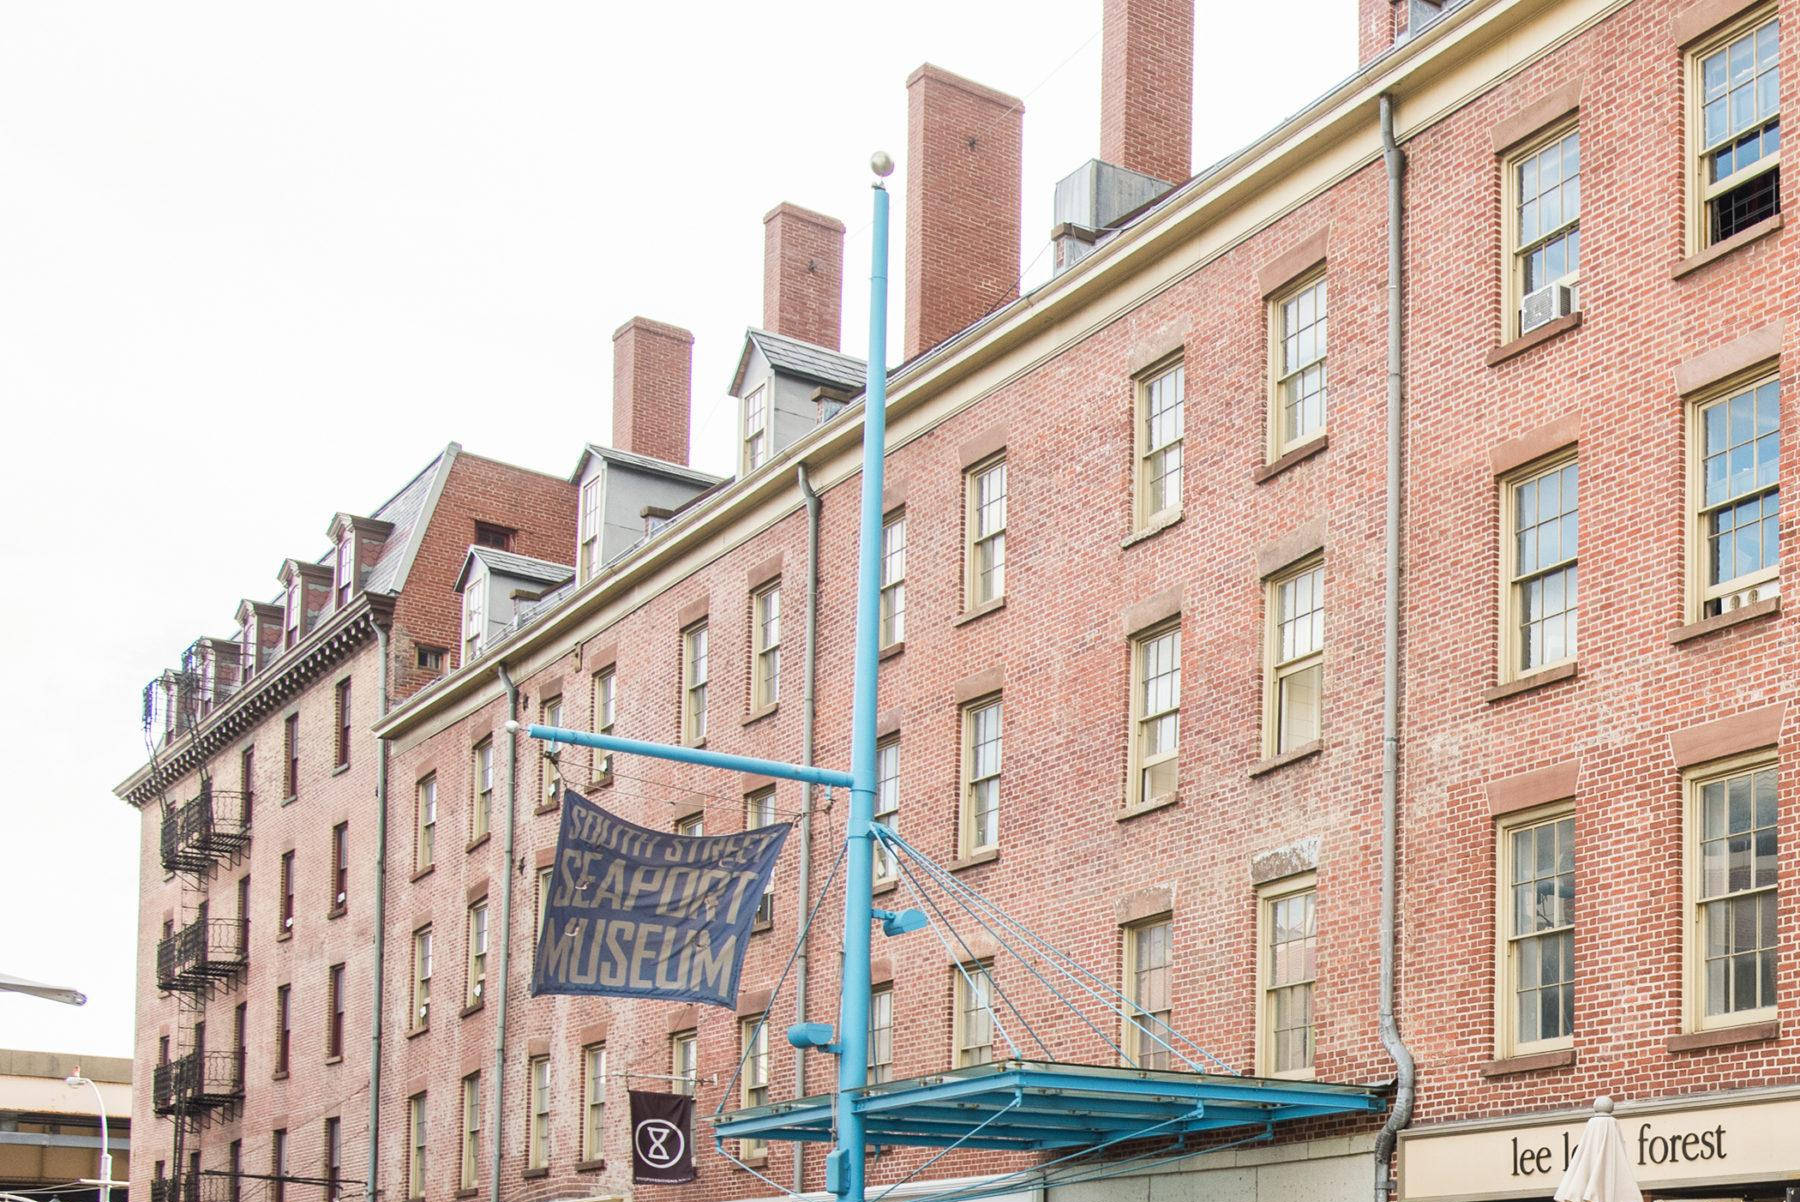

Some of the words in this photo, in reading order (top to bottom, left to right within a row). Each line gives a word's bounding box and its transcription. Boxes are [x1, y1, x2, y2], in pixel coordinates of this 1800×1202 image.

[569, 805, 661, 858] SOUTH
[664, 832, 779, 867] STREET
[553, 849, 759, 924] SEAPORT
[537, 915, 737, 998] MUSEUM
[1511, 1136, 1552, 1176] lee
[1637, 1122, 1727, 1166] forest
